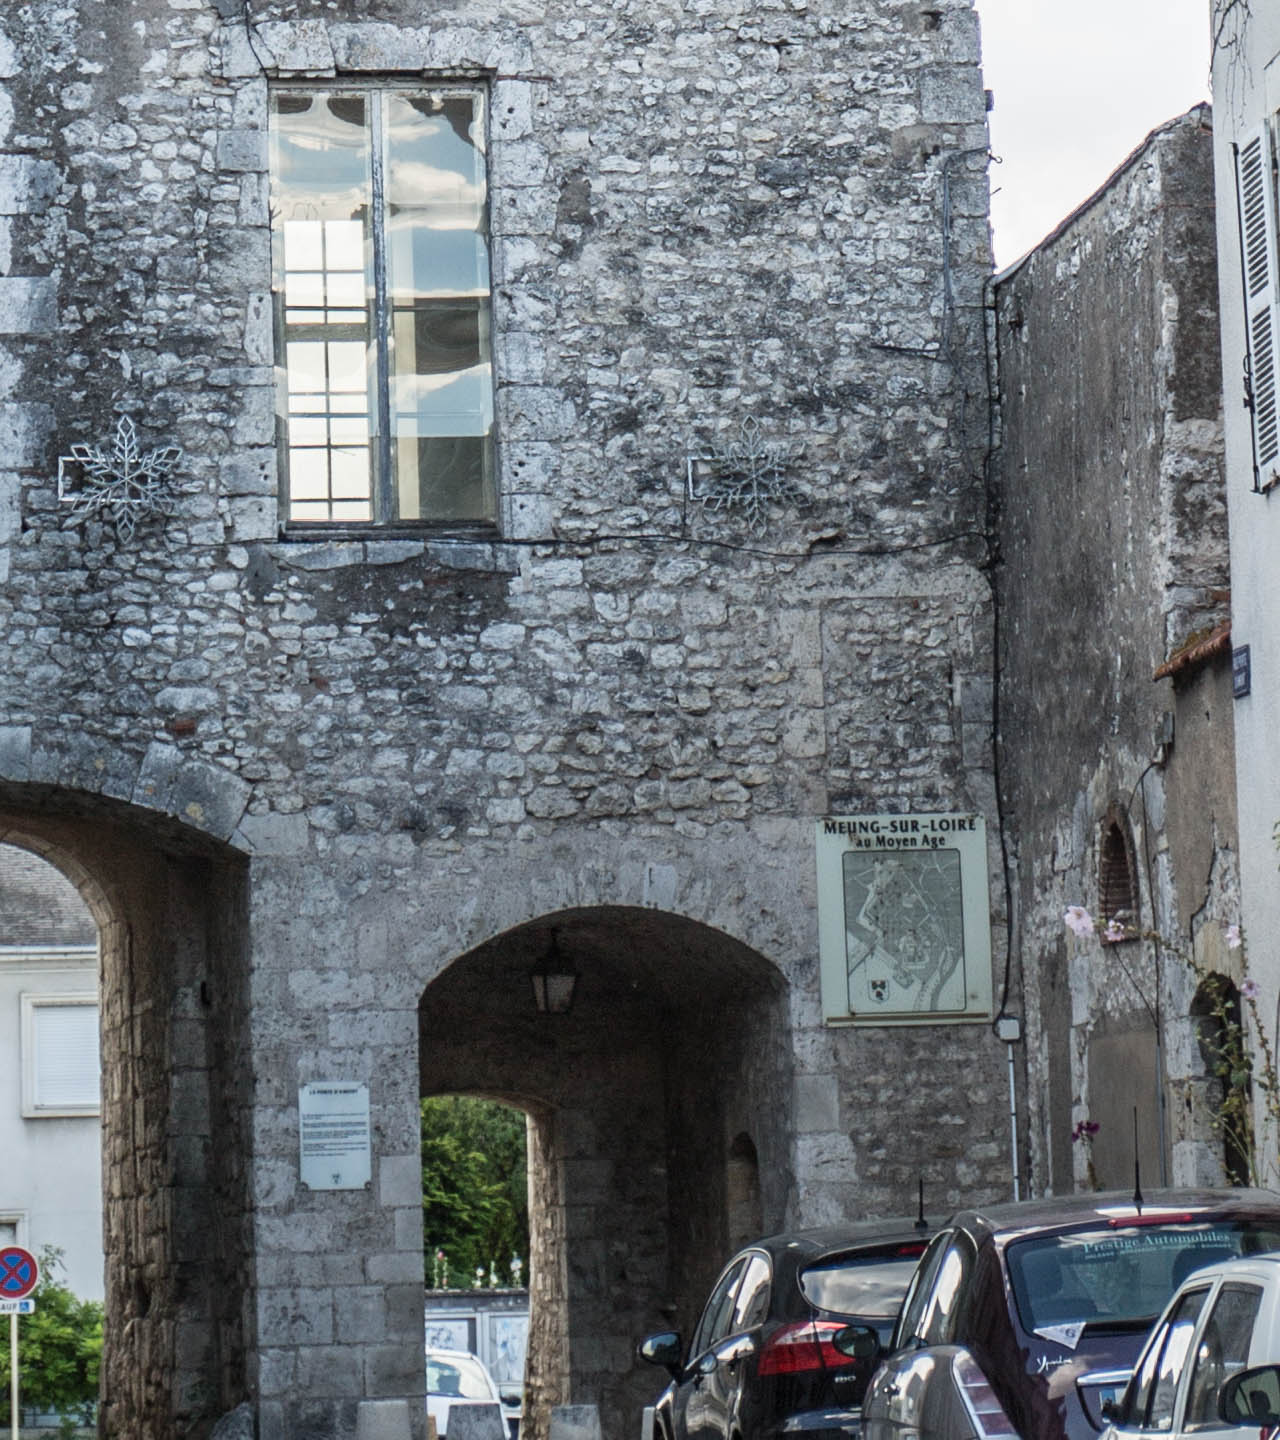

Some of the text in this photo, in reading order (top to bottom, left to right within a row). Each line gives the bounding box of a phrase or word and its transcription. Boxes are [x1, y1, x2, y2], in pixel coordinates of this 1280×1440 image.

[823, 818, 977, 834] MEUNG-SUR-LOIRE
[856, 833, 946, 849] au Moyen Age
[1083, 1236, 1140, 1254] Prestige
[1143, 1230, 1231, 1247] Automobiles
